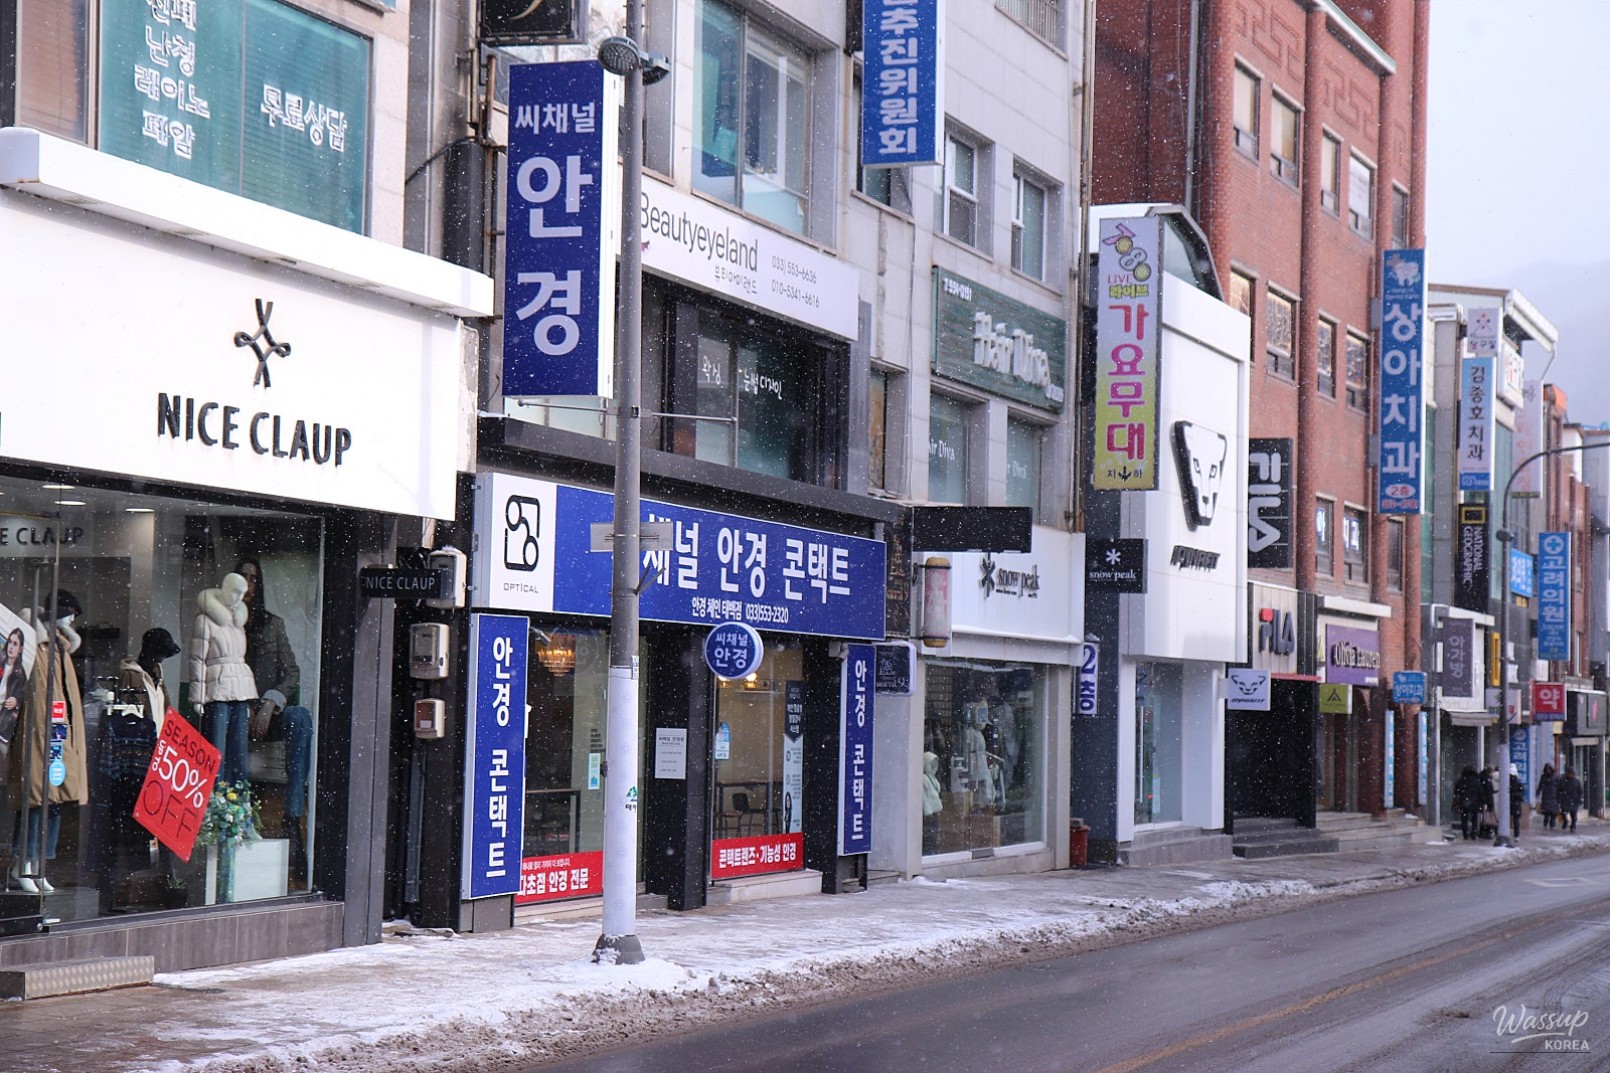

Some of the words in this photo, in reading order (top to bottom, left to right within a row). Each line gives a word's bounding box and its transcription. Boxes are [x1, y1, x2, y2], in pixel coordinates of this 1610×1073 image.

[134, 63, 211, 119] 레이노
[879, 0, 919, 154] 추진위원회
[142, 109, 196, 160] 폐암
[260, 83, 348, 153] 무료상담
[514, 102, 595, 135] 씨채널
[515, 155, 594, 356] 안경
[1107, 303, 1150, 460] 가요무대
[1383, 303, 1423, 479] 상아치과
[157, 392, 240, 450] NICE
[249, 411, 352, 468] CLAUP
[365, 576, 393, 590] NICE
[396, 577, 436, 590] CLAUP
[503, 582, 540, 594] OPTICAL
[717, 527, 768, 598] 안경
[782, 538, 851, 604] 콘택트
[1089, 571, 1113, 579] snow
[1114, 569, 1136, 582] peak
[691, 596, 707, 618] 안경
[1258, 607, 1296, 656] FILA
[714, 648, 748, 669] 안경
[715, 632, 748, 647] 씨채널
[492, 637, 513, 727] 안경
[855, 660, 867, 728] 안경
[164, 719, 216, 776] SEASON
[158, 745, 208, 809] 50%
[851, 743, 865, 841] 콘택트
[142, 779, 199, 839] OFF
[485, 749, 509, 878] 콘택트
[549, 869, 568, 893] 안경
[571, 867, 589, 890] 전문
[782, 842, 797, 862] 안경
